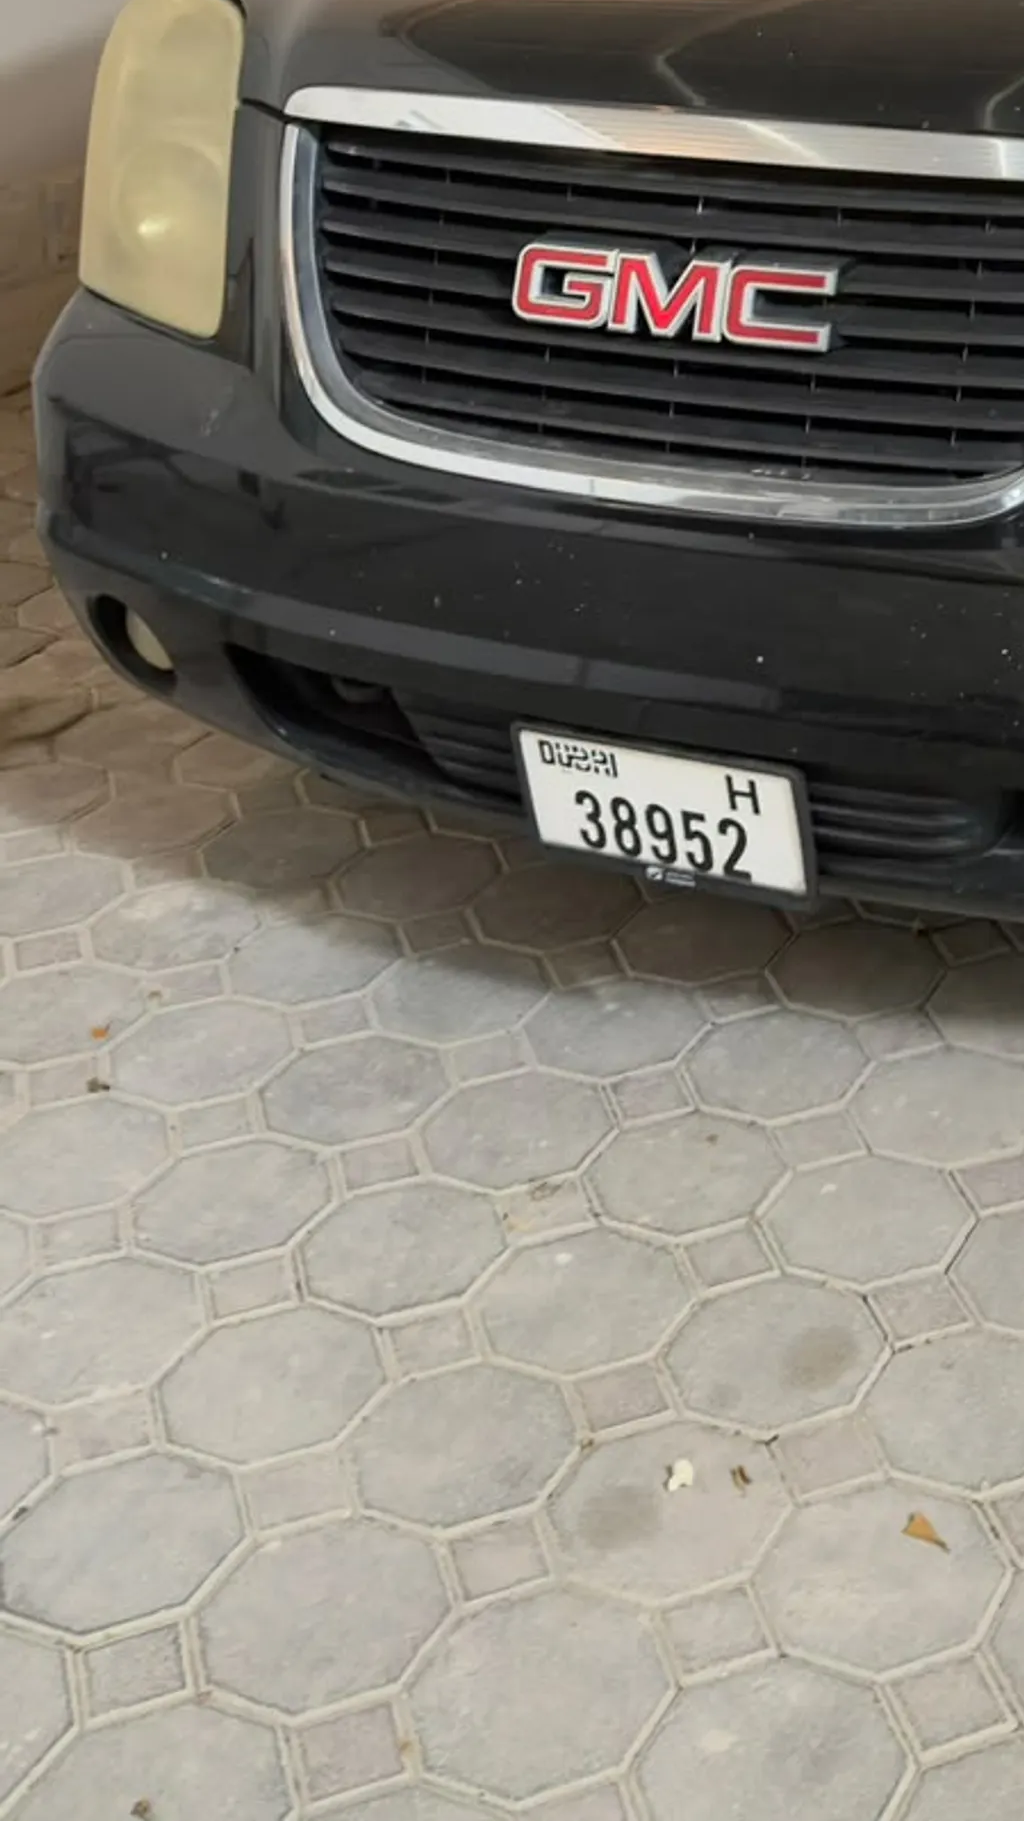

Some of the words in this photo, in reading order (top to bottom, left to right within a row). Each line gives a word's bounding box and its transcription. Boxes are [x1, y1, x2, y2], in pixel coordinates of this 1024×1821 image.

[512, 243, 838, 353] GMC
[574, 790, 752, 880] 38952
[725, 774, 761, 815] H
